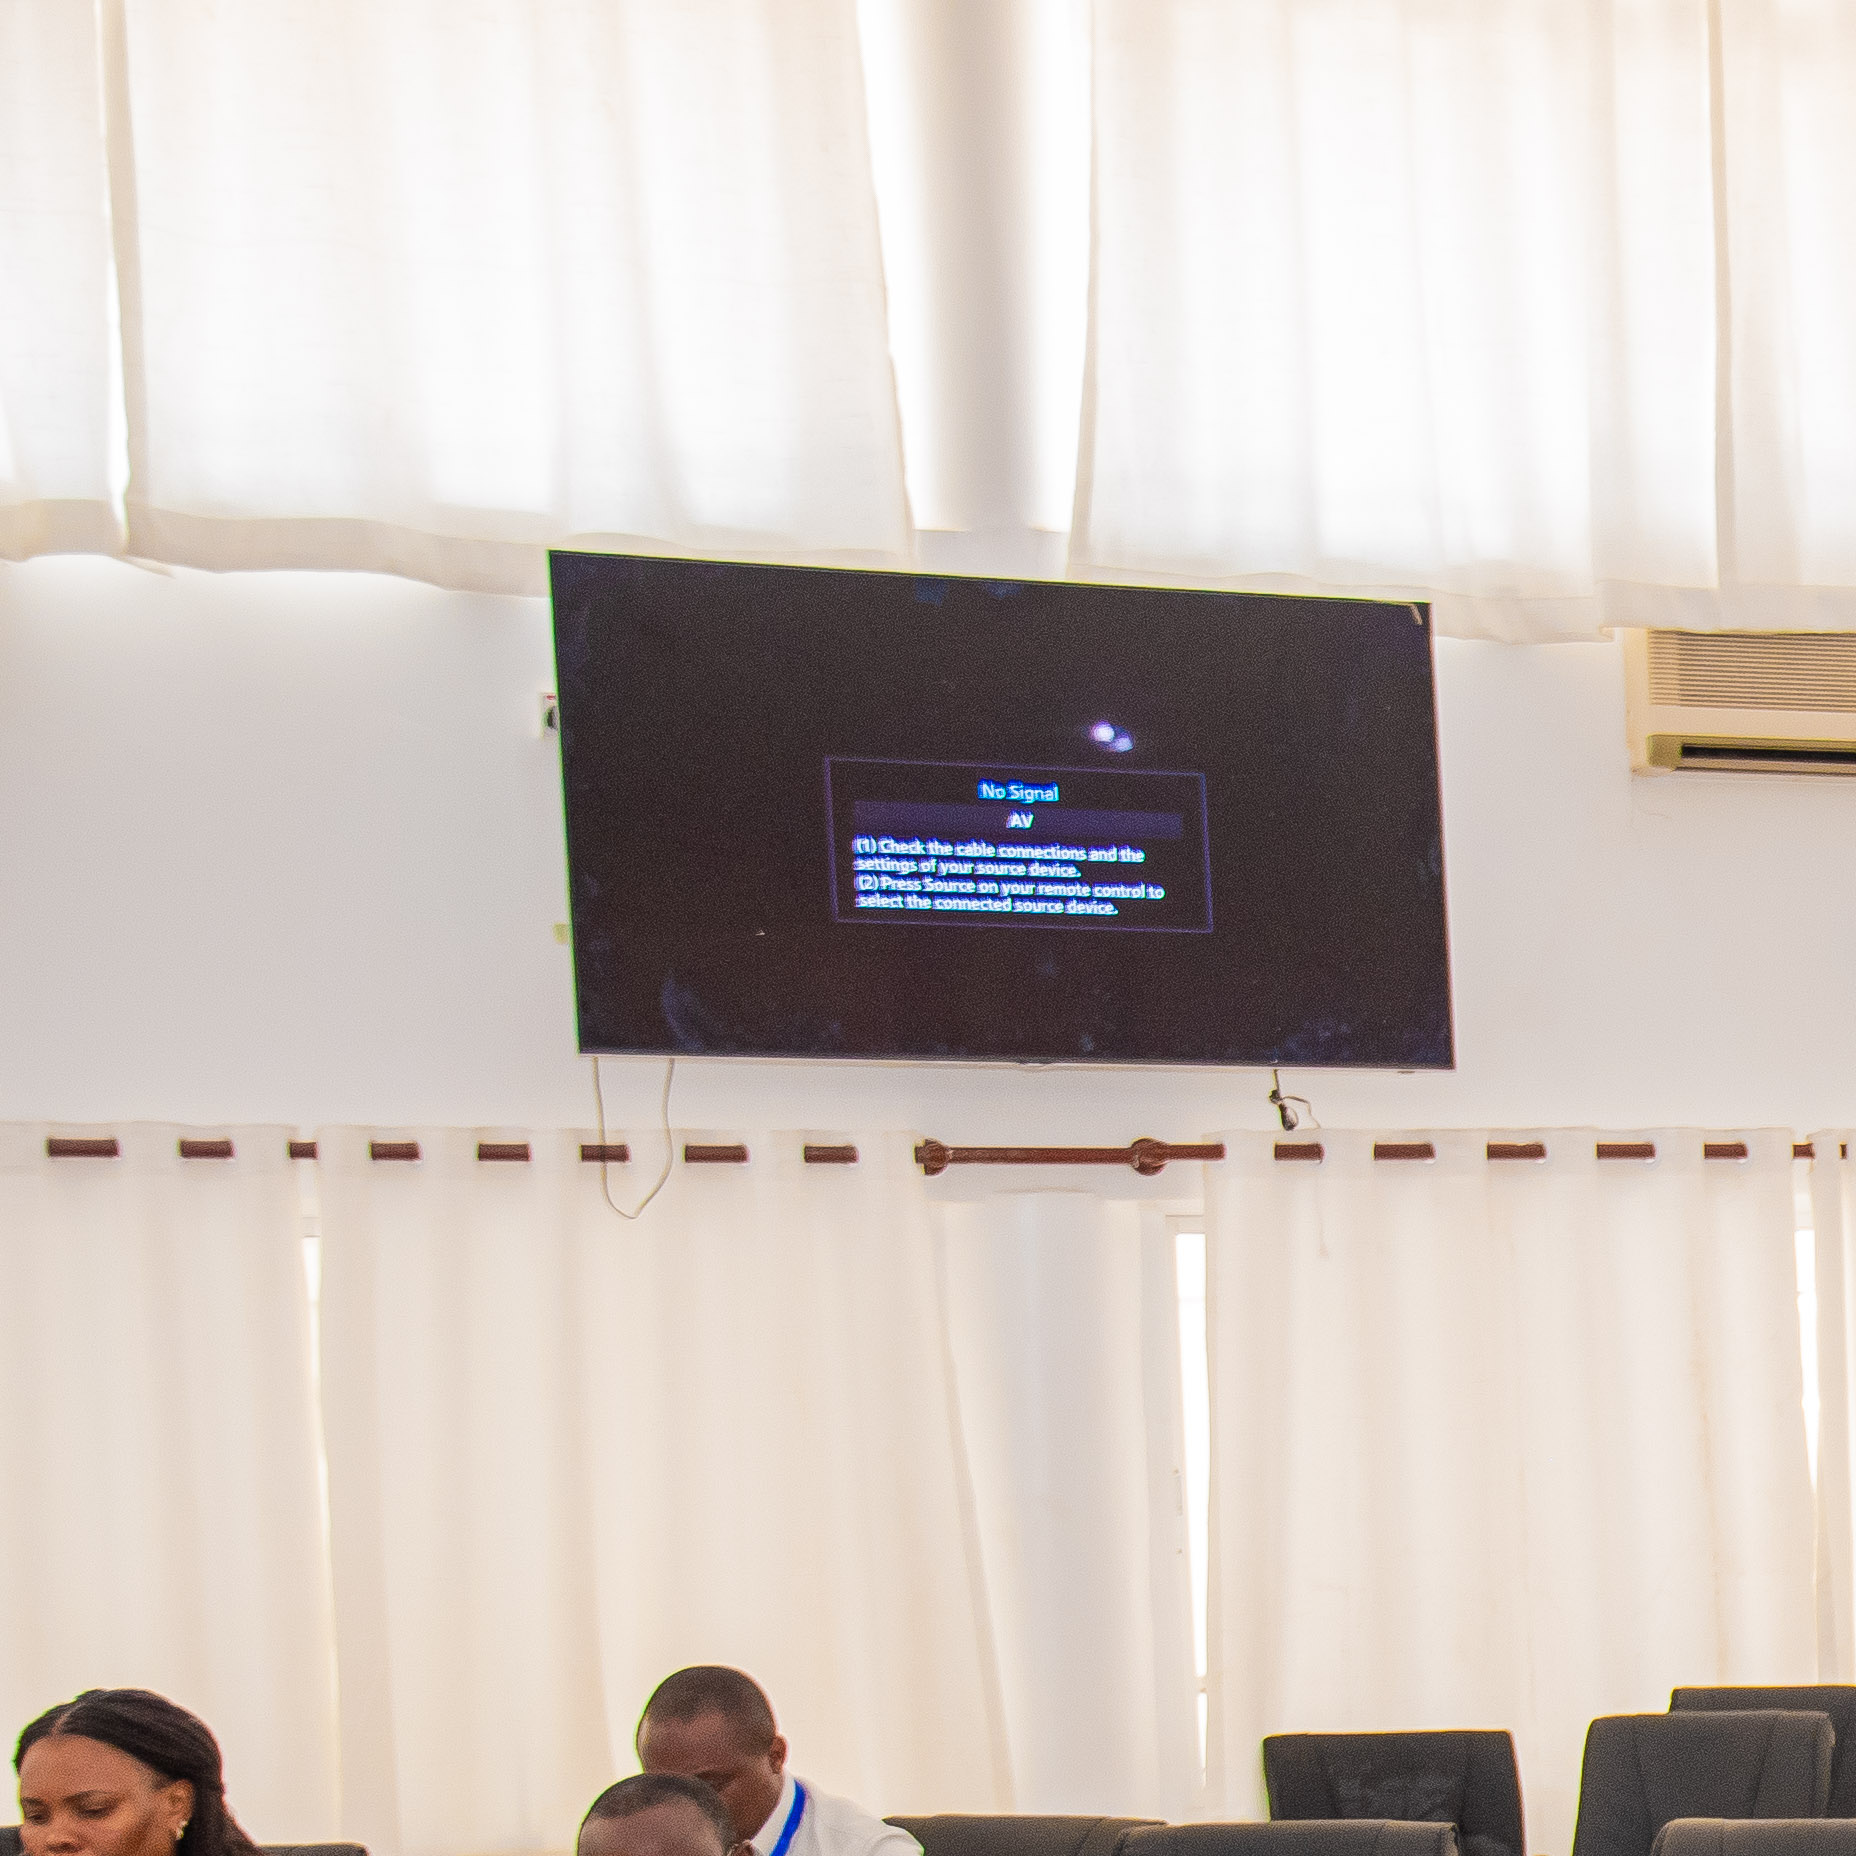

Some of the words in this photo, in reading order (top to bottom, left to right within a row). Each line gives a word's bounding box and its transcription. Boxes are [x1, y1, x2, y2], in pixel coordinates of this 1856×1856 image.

[978, 780, 1006, 799] No
[1007, 781, 1059, 803] Signal
[1007, 811, 1034, 829] AV
[855, 836, 877, 854] (1)
[878, 837, 926, 854] Check
[926, 838, 953, 855] the
[954, 841, 996, 857] cable
[997, 844, 1087, 860] connections
[1088, 845, 1118, 861] and
[1118, 846, 1145, 862] the
[854, 856, 918, 874] settings
[918, 858, 937, 872] of
[938, 860, 974, 876] your
[974, 862, 1026, 875] source
[1027, 861, 1081, 877] device.
[856, 873, 878, 891] (2)
[879, 874, 922, 891] Press
[922, 876, 976, 892] Source
[977, 880, 999, 894] on
[1000, 880, 1036, 897] your
[1036, 882, 1091, 896] remote
[1092, 883, 1146, 899] control
[1146, 884, 1165, 899] to
[856, 893, 904, 907] select
[904, 895, 932, 909] the
[932, 897, 1012, 912] connected
[1012, 899, 1064, 913] source
[1064, 900, 1118, 915] device.
